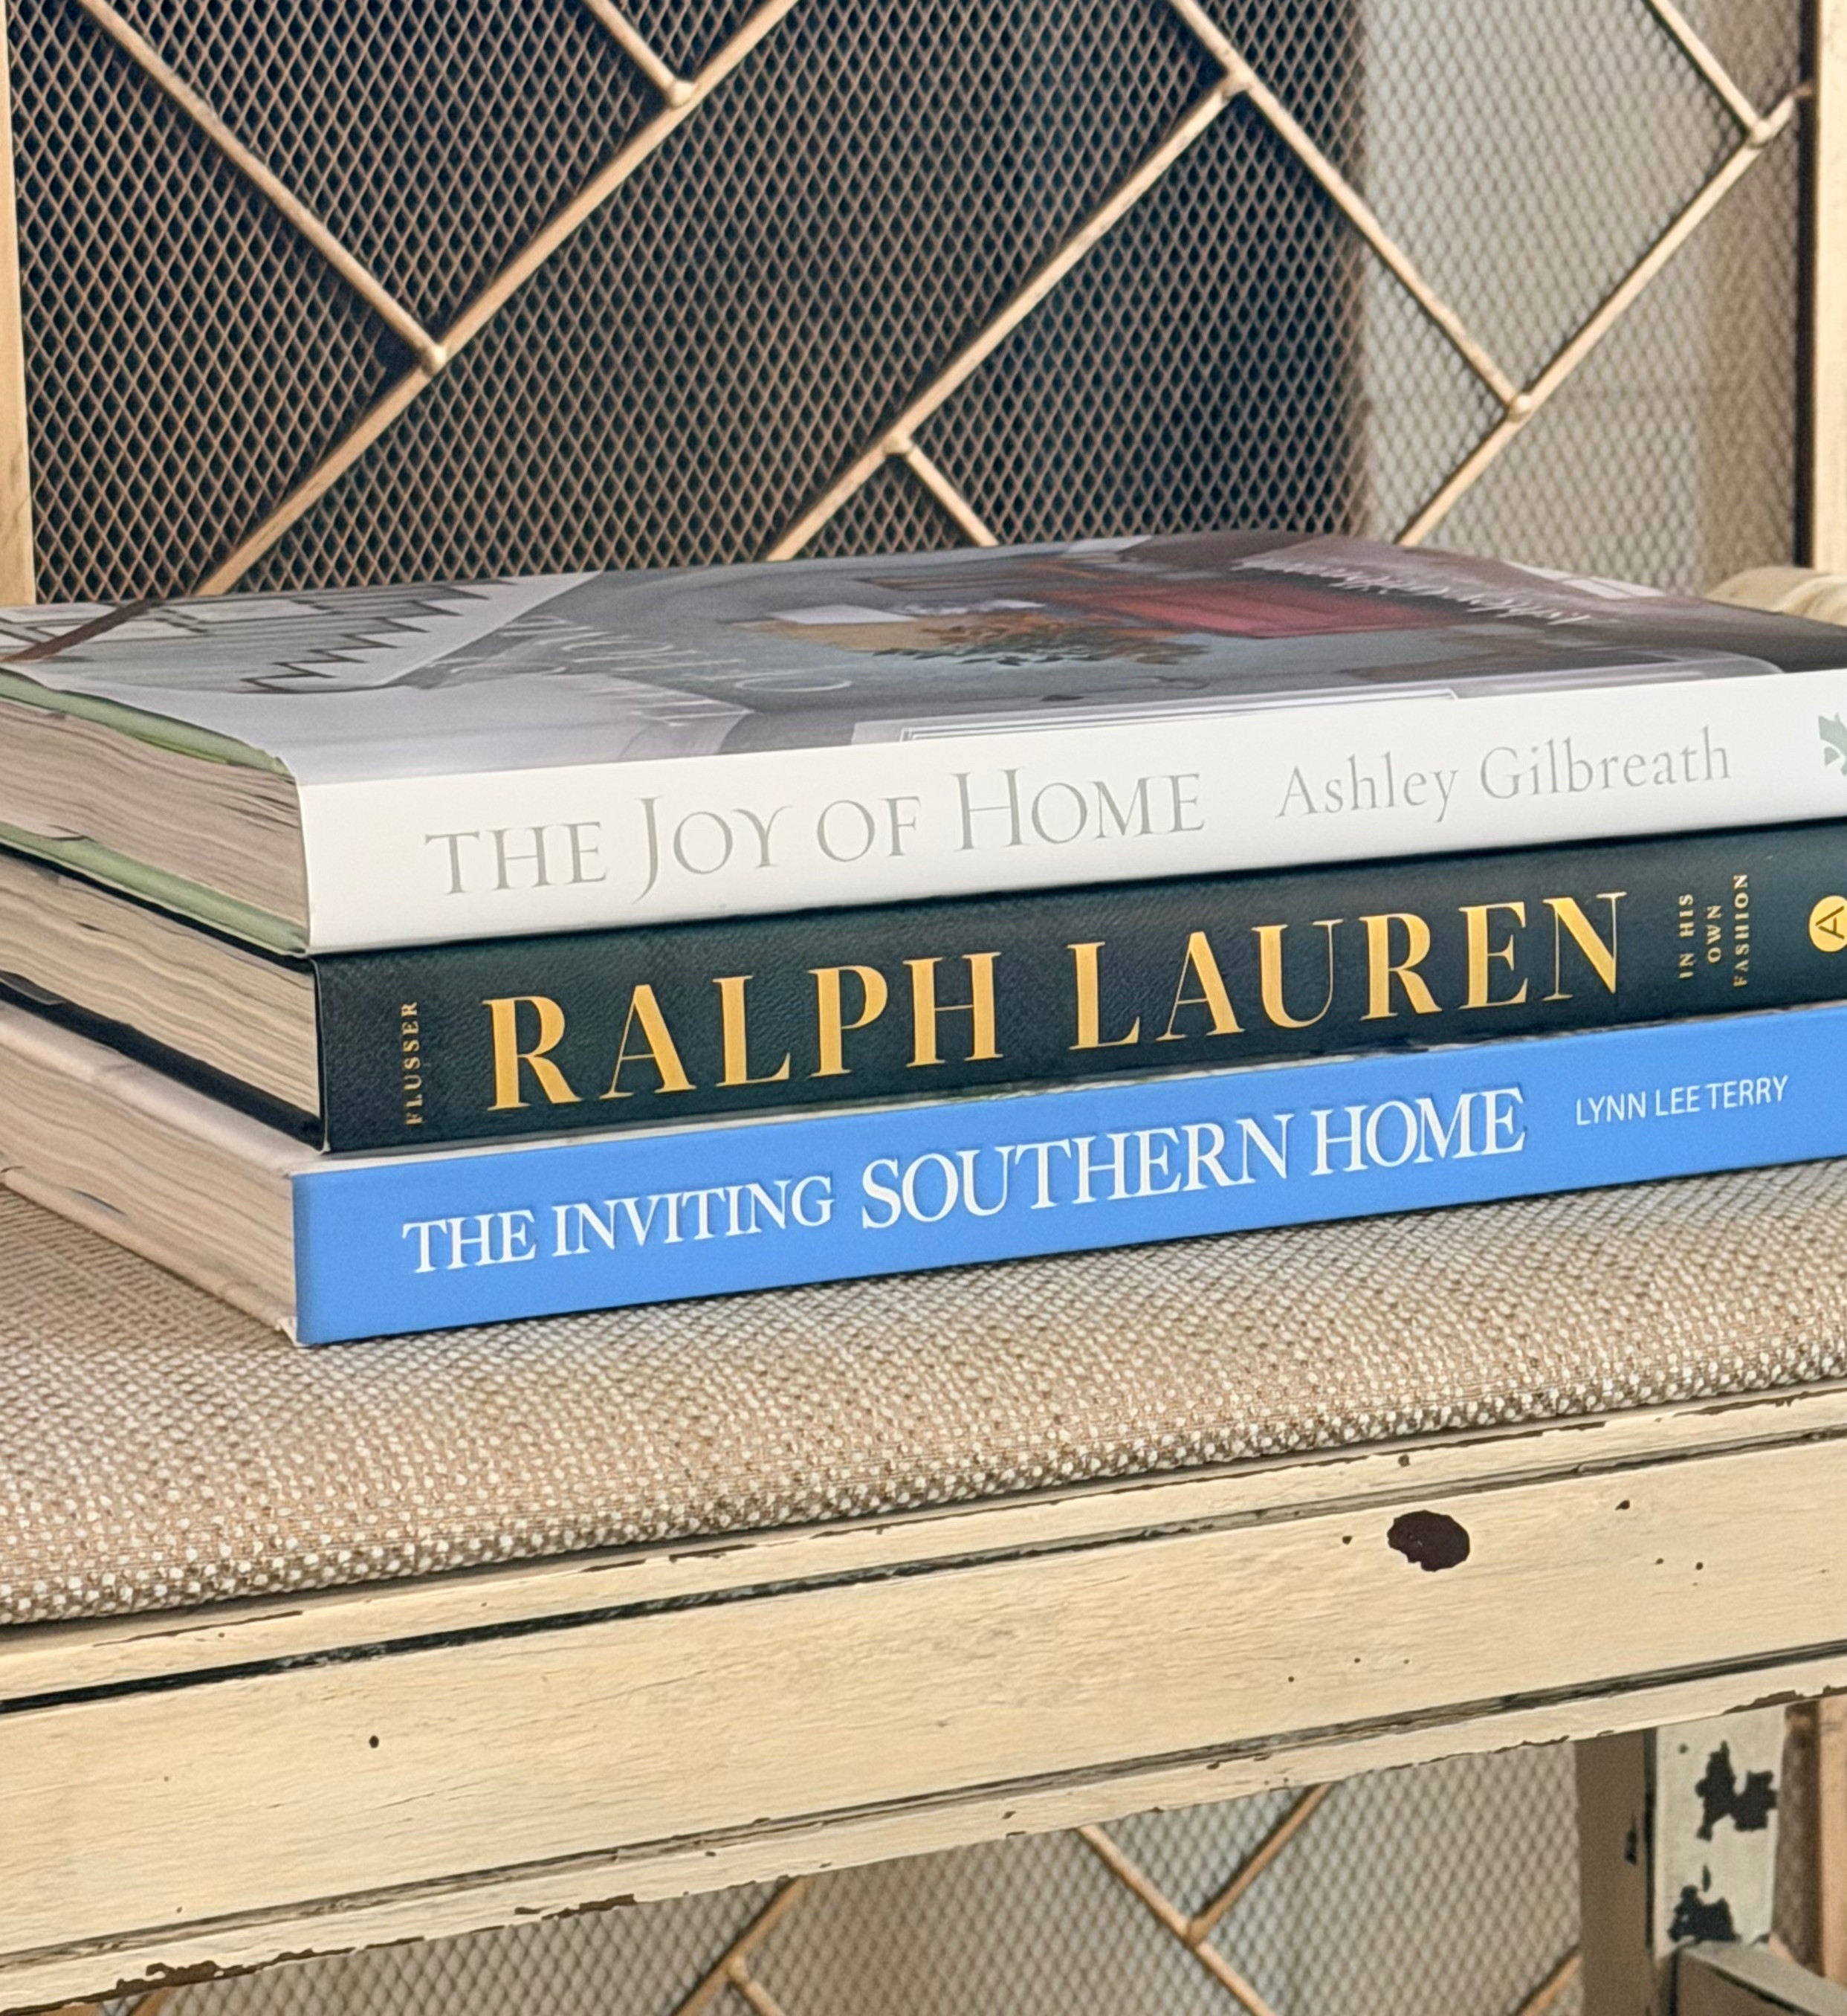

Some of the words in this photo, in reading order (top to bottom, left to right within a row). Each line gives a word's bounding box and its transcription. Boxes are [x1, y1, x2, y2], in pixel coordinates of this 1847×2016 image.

[1274, 750, 1461, 823] Ashley
[1480, 726, 1732, 800] Gilbreath
[424, 821, 608, 895] THE
[816, 795, 922, 863] OF
[1678, 893, 1695, 938] HIS
[1705, 904, 1723, 964] OWN
[1732, 873, 1750, 987] FASHION
[482, 951, 1000, 1111] RALPH
[1068, 891, 1628, 1050] LAUREN
[1678, 952, 1695, 979] IN
[401, 1001, 424, 1125] FLUSSER
[1575, 1091, 1647, 1125] LYNN
[1654, 1085, 1701, 1117] LEE
[1706, 1075, 1789, 1111] TERRY
[401, 1209, 537, 1274] THE
[552, 1175, 834, 1258] INVITING
[861, 1114, 1290, 1230] SOUTHERN
[1310, 1087, 1527, 1177] HOME
